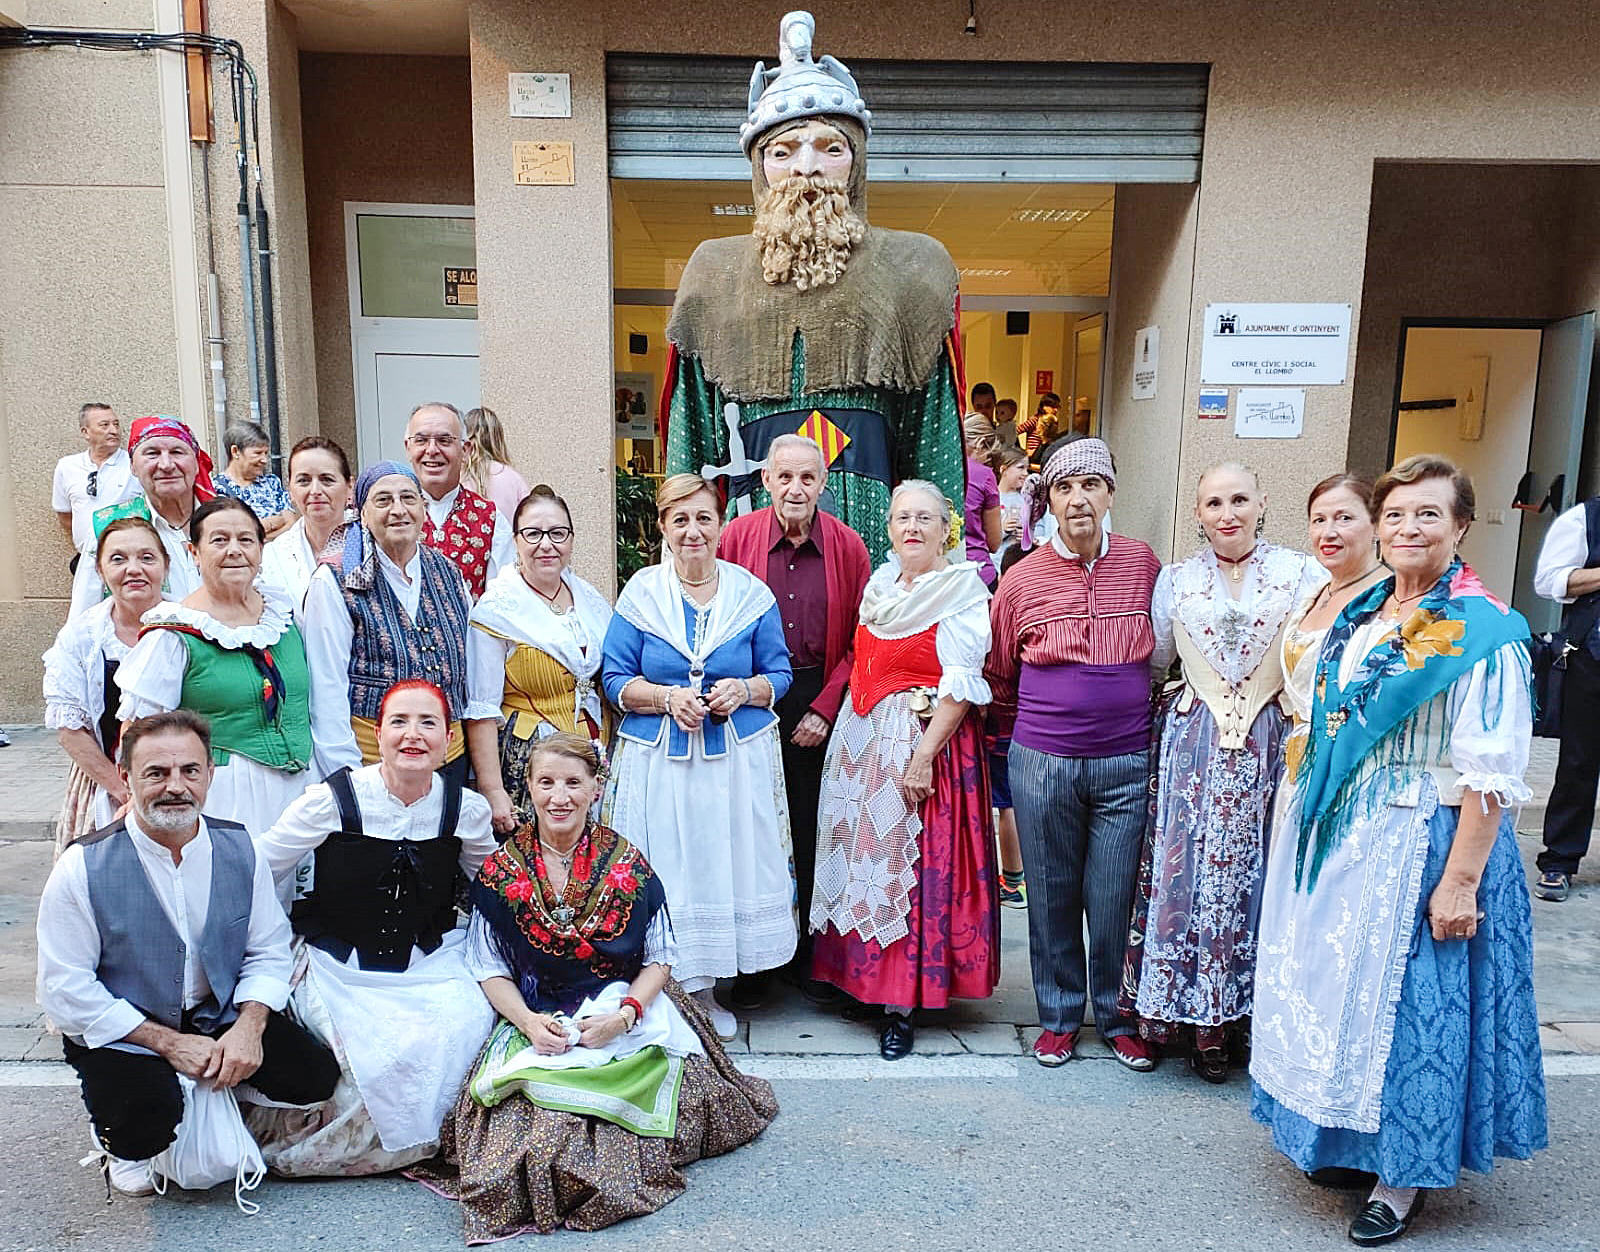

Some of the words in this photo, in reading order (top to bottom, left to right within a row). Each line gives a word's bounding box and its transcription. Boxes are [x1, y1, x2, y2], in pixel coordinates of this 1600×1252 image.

[446, 270, 458, 283] SE
[1245, 325, 1289, 333] AJUNTAMENT
[1292, 325, 1341, 333] d'ONTINYENT
